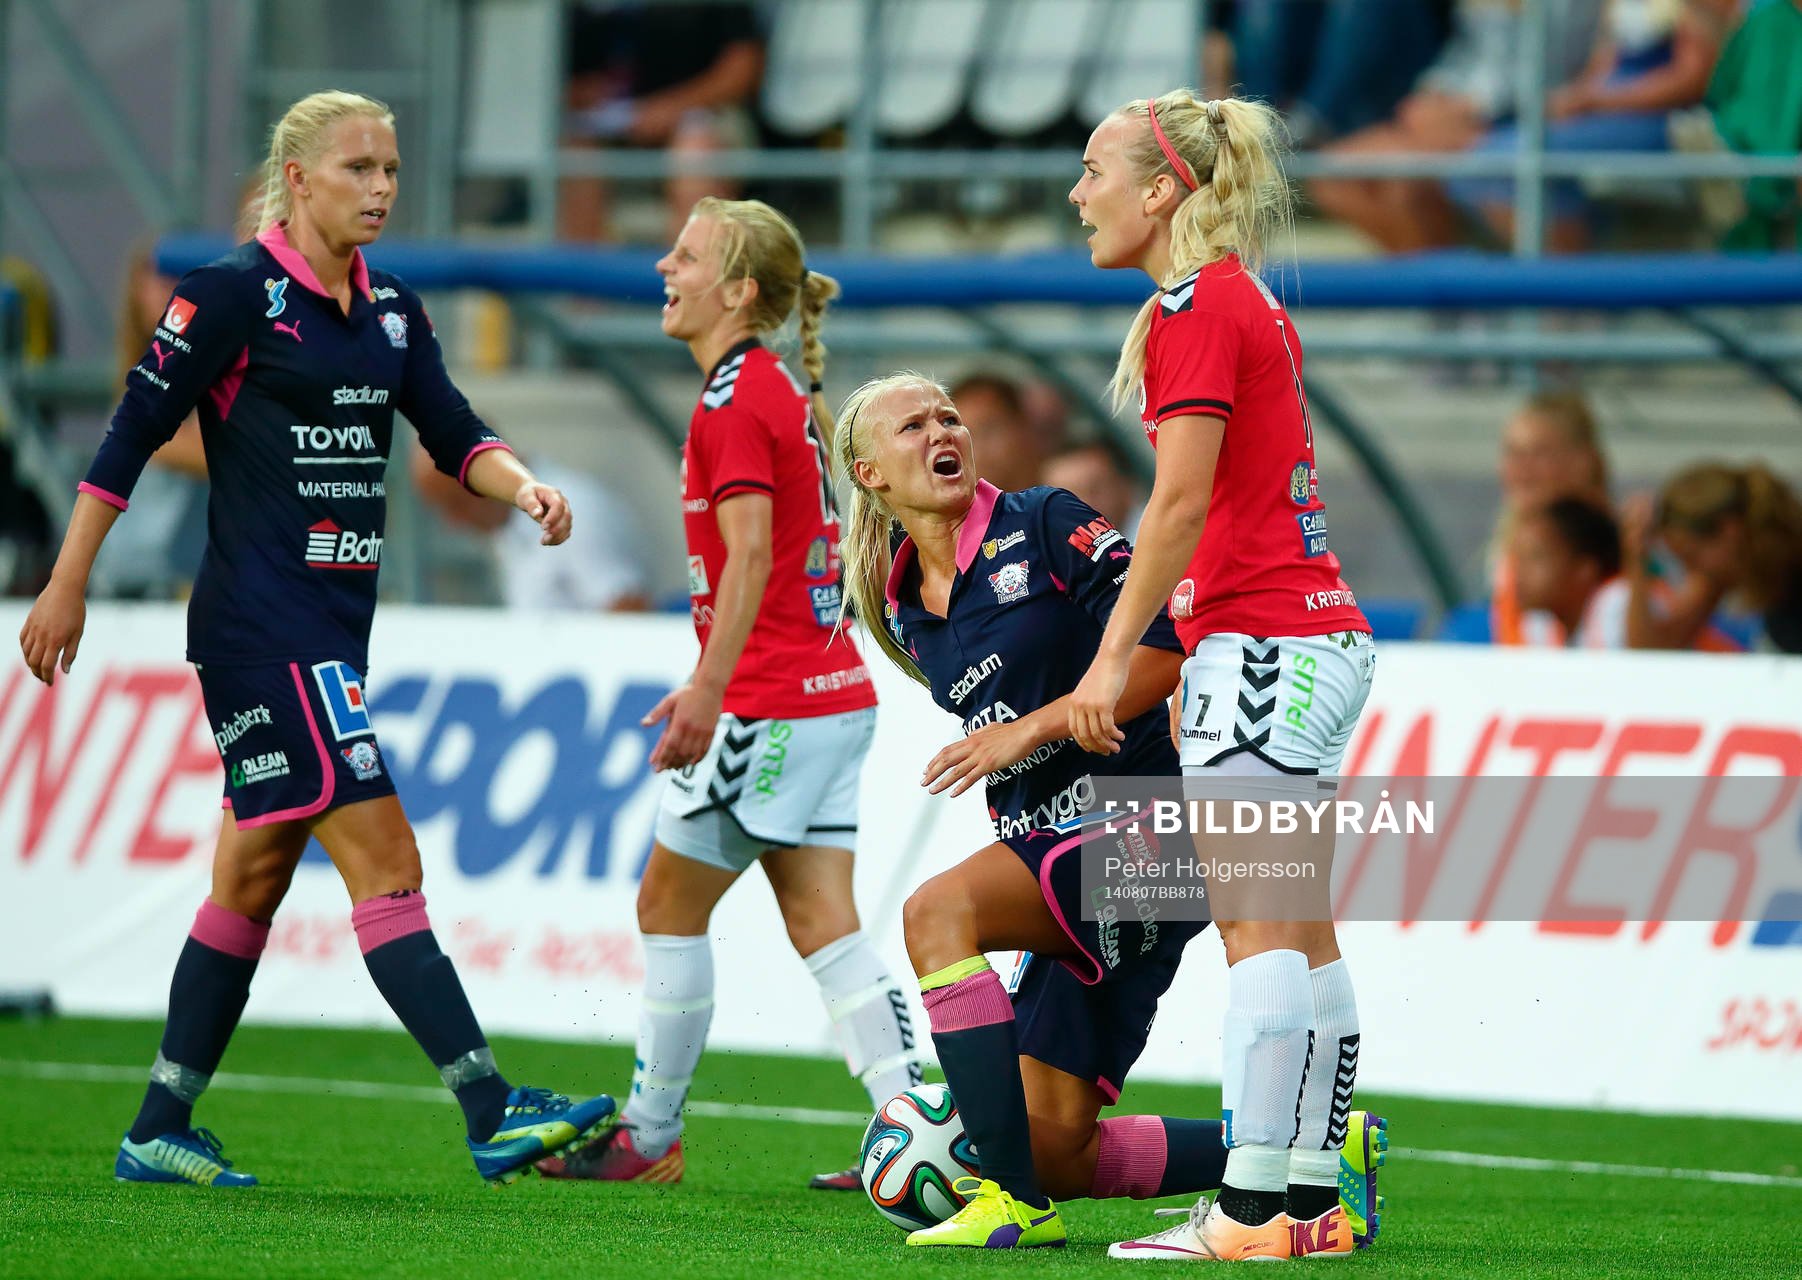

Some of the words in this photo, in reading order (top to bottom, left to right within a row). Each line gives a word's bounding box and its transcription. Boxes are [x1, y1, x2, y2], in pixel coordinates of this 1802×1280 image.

[332, 385, 389, 405] stadium
[290, 425, 376, 451] TOYOTA
[297, 481, 370, 499] MATERIAL
[336, 530, 385, 563] Botr
[948, 653, 1004, 706] stadium
[1285, 653, 1317, 731] PLUS
[963, 700, 1019, 738] YOTA
[1194, 693, 1212, 727] 7
[1179, 727, 1221, 742] hummel
[241, 750, 289, 775] QLEAN
[754, 720, 793, 797] PLUS
[1332, 707, 1802, 950] INTER
[1115, 838, 1131, 861] 106.9
[1102, 904, 1121, 969] QLEAN
[1288, 1207, 1341, 1257] IKE
